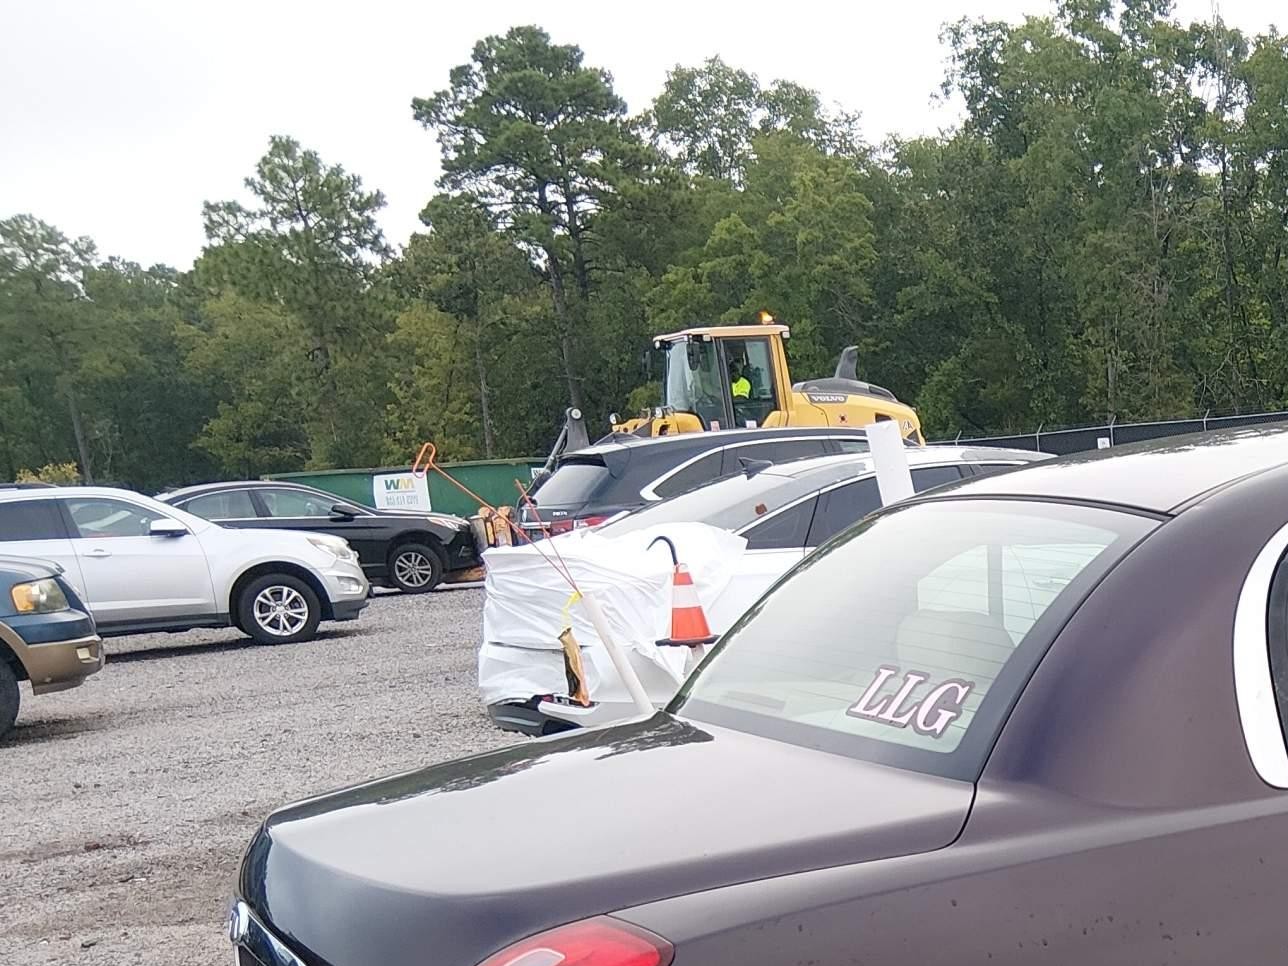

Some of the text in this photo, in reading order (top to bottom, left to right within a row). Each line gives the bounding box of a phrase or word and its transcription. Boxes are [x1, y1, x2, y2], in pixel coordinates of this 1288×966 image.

[811, 394, 845, 402] VOLVO
[384, 479, 415, 490] WM
[847, 666, 973, 737] LLG
